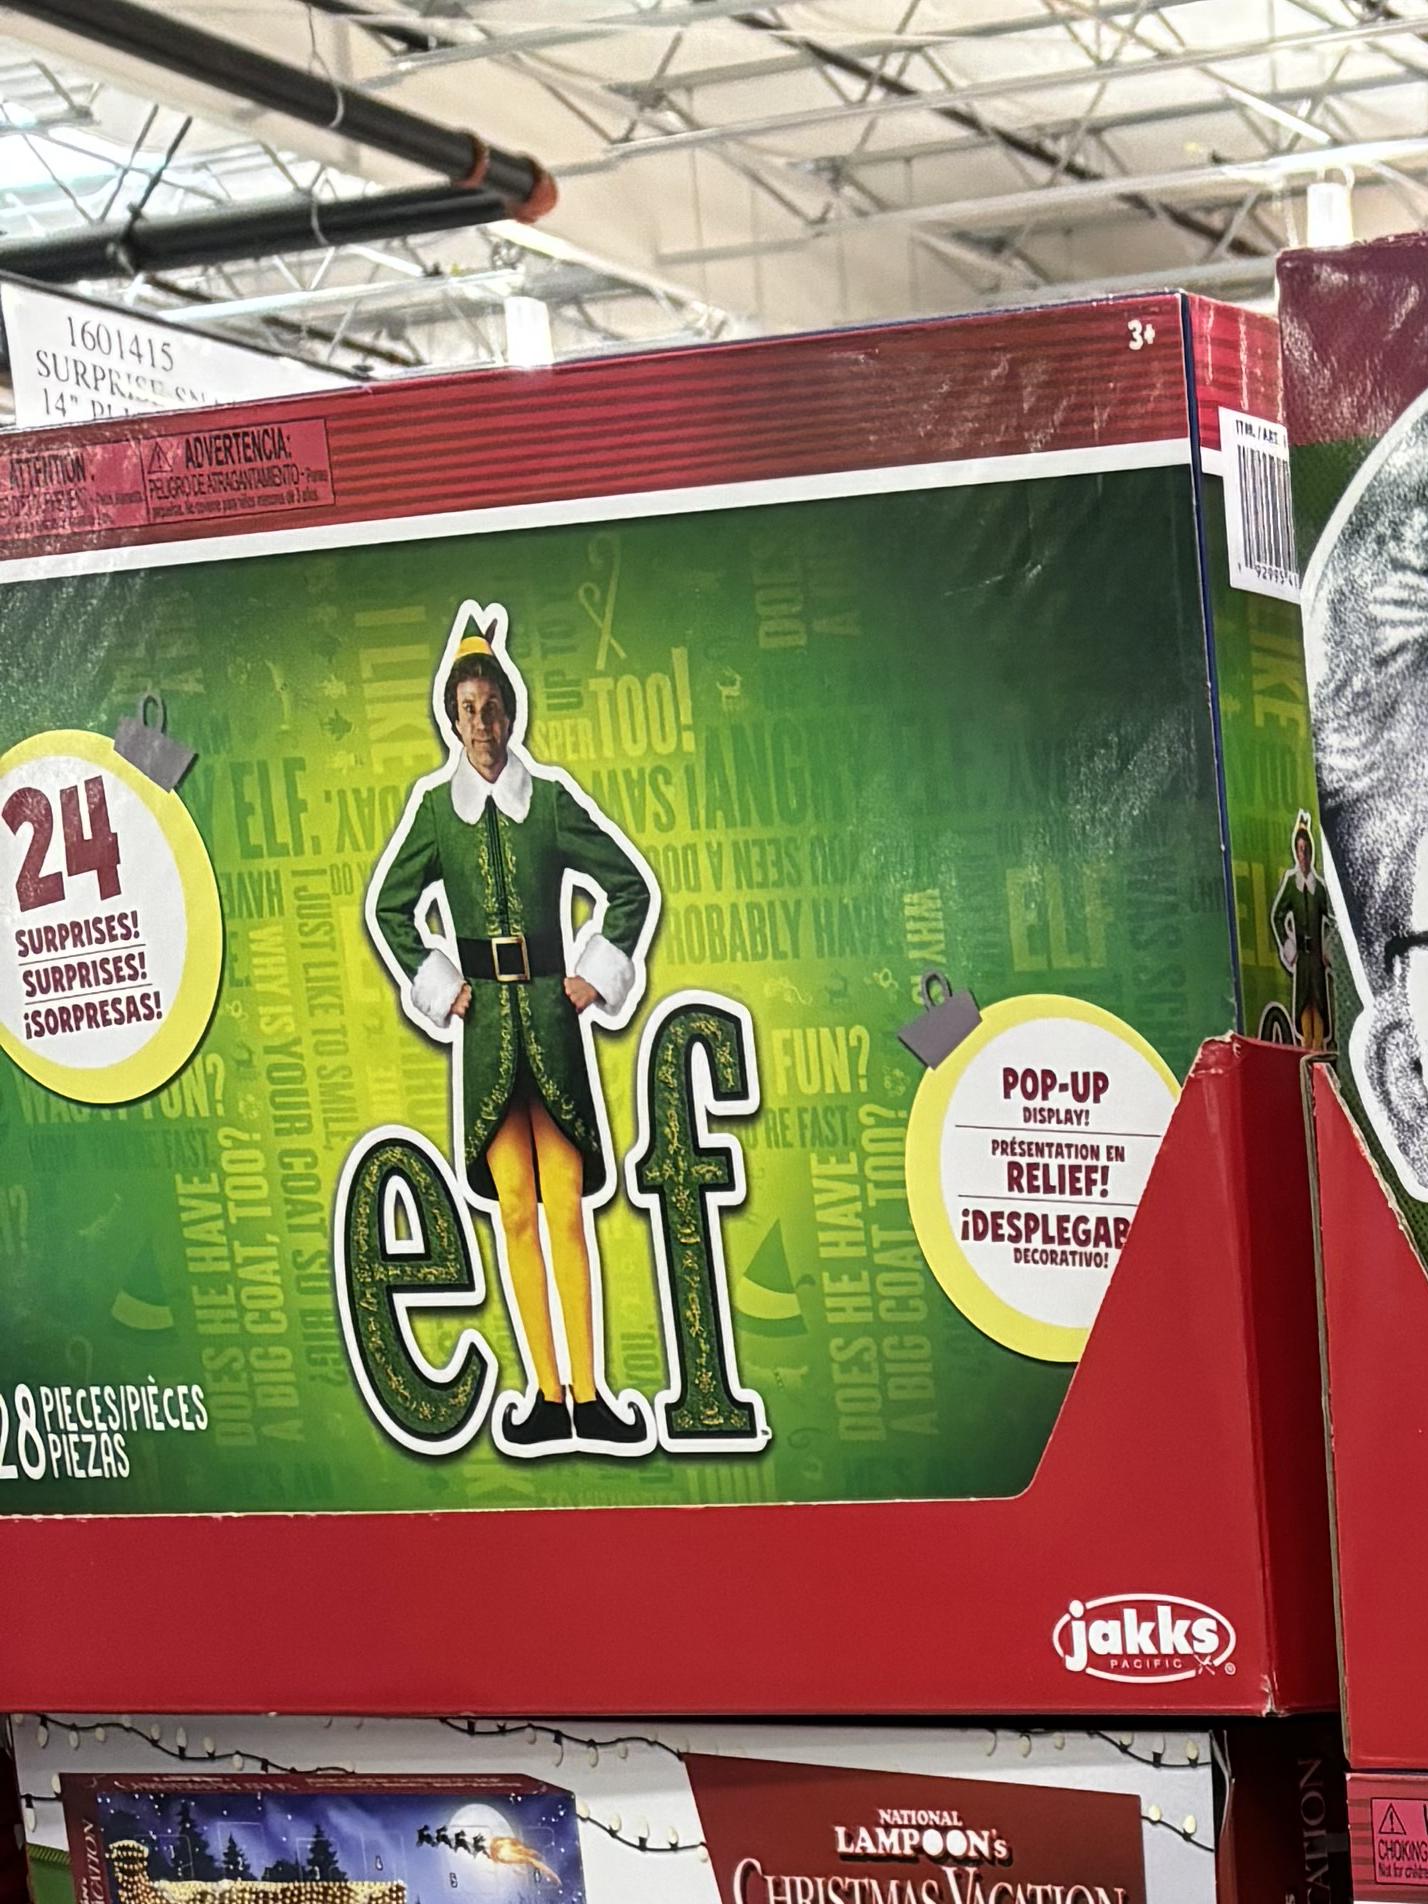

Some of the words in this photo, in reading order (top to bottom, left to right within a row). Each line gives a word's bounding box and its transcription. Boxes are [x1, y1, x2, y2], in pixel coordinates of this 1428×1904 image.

[67, 316, 174, 371] 1601415
[1127, 319, 1156, 351] 3+
[184, 428, 292, 470] ADVERTENCIA:
[1, 775, 121, 912] 24
[15, 911, 140, 957] SURPRISES!
[23, 952, 147, 997] SURPRISES!
[24, 991, 162, 1039] ¡SORPRESAS!
[1002, 1067, 1109, 1103] POP-UP
[1023, 1107, 1090, 1126] DISPLAY!
[991, 1137, 1100, 1161] PRÉSENTATION
[1106, 1145, 1125, 1162] EN
[1007, 1161, 1109, 1198] RELIEF!
[1014, 1248, 1108, 1268] DECORATIVO!
[40, 1374, 208, 1431] PIECES/PIÈCES
[48, 1433, 130, 1478] PIEZAS
[1065, 1600, 1219, 1671] jakks
[1110, 1658, 1183, 1669] PACIFIC
[879, 1808, 963, 1827] NATIONAL
